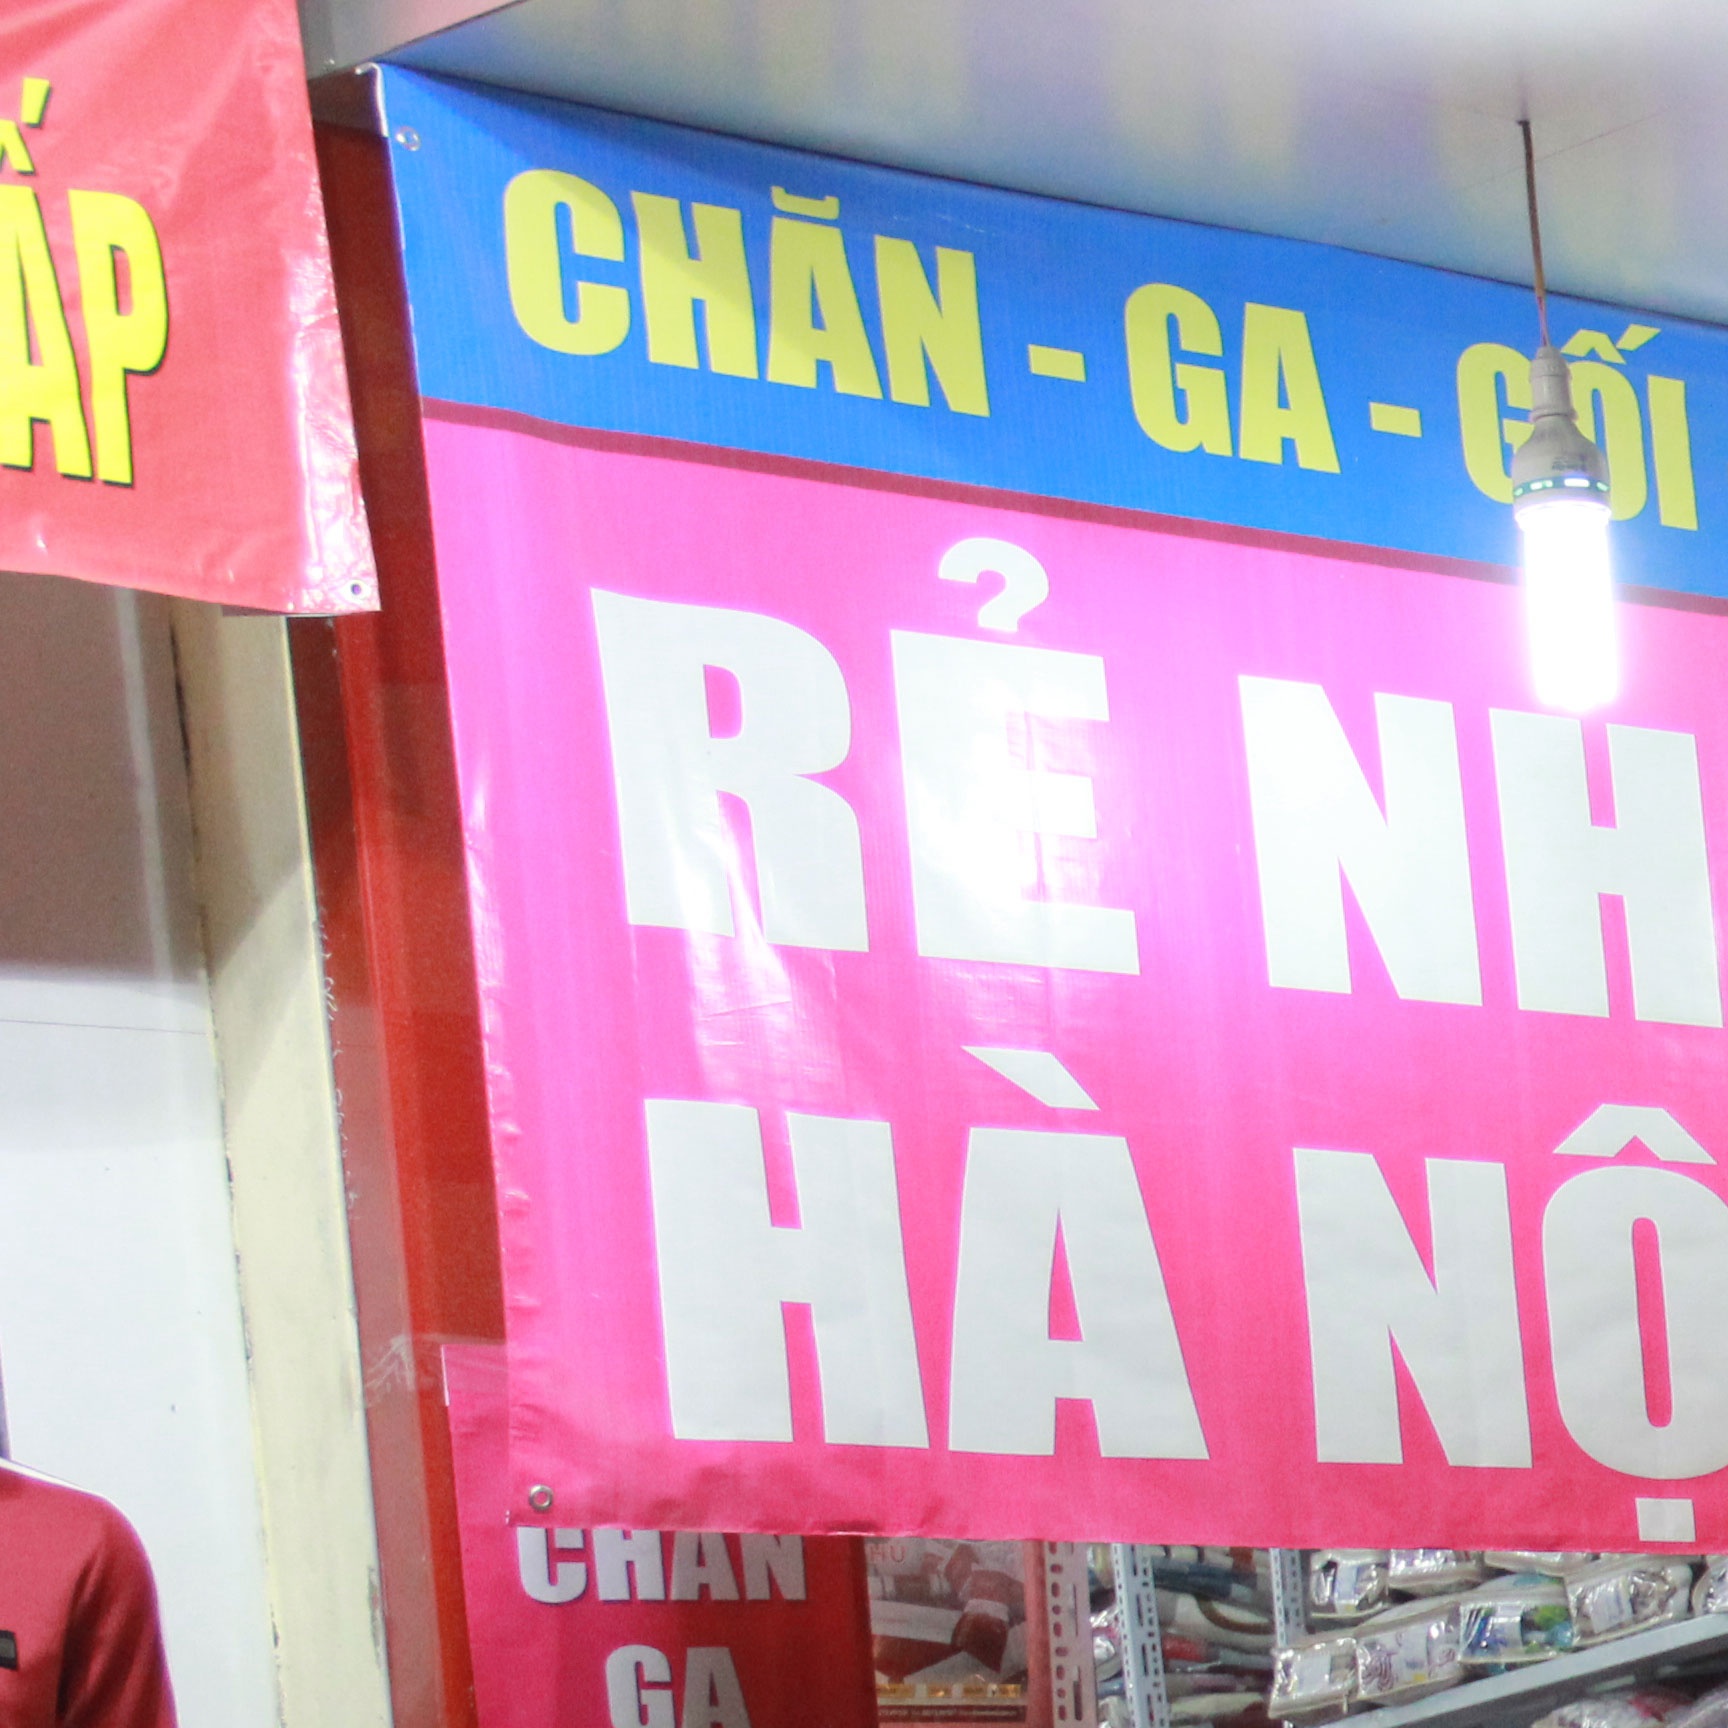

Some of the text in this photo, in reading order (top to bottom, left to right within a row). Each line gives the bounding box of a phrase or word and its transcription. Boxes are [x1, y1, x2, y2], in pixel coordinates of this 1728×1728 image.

[502, 168, 990, 418] CHĂN
[1123, 281, 1340, 475] GA
[1455, 324, 1699, 531] GỐI
[590, 536, 1142, 976] RẺ
[644, 1045, 1210, 1460] HÀ
